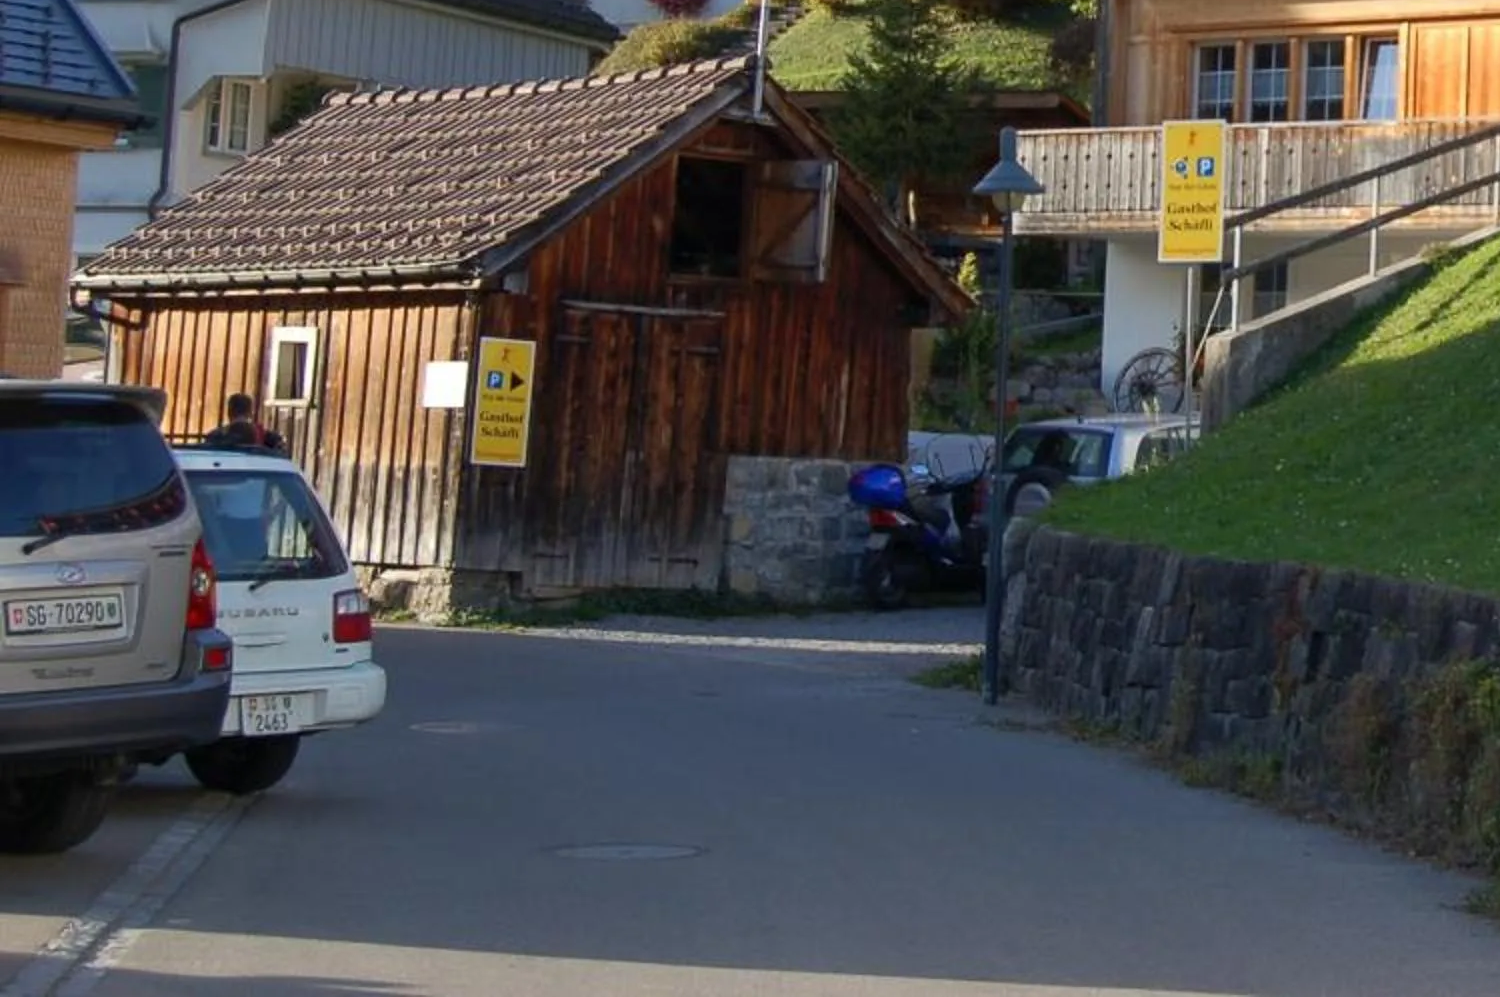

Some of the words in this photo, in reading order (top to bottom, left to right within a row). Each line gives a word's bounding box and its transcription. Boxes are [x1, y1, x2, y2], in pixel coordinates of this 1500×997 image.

[1167, 202, 1217, 214] Gasthof
[480, 411, 523, 423] Gasthof
[255, 712, 289, 732] 2463
